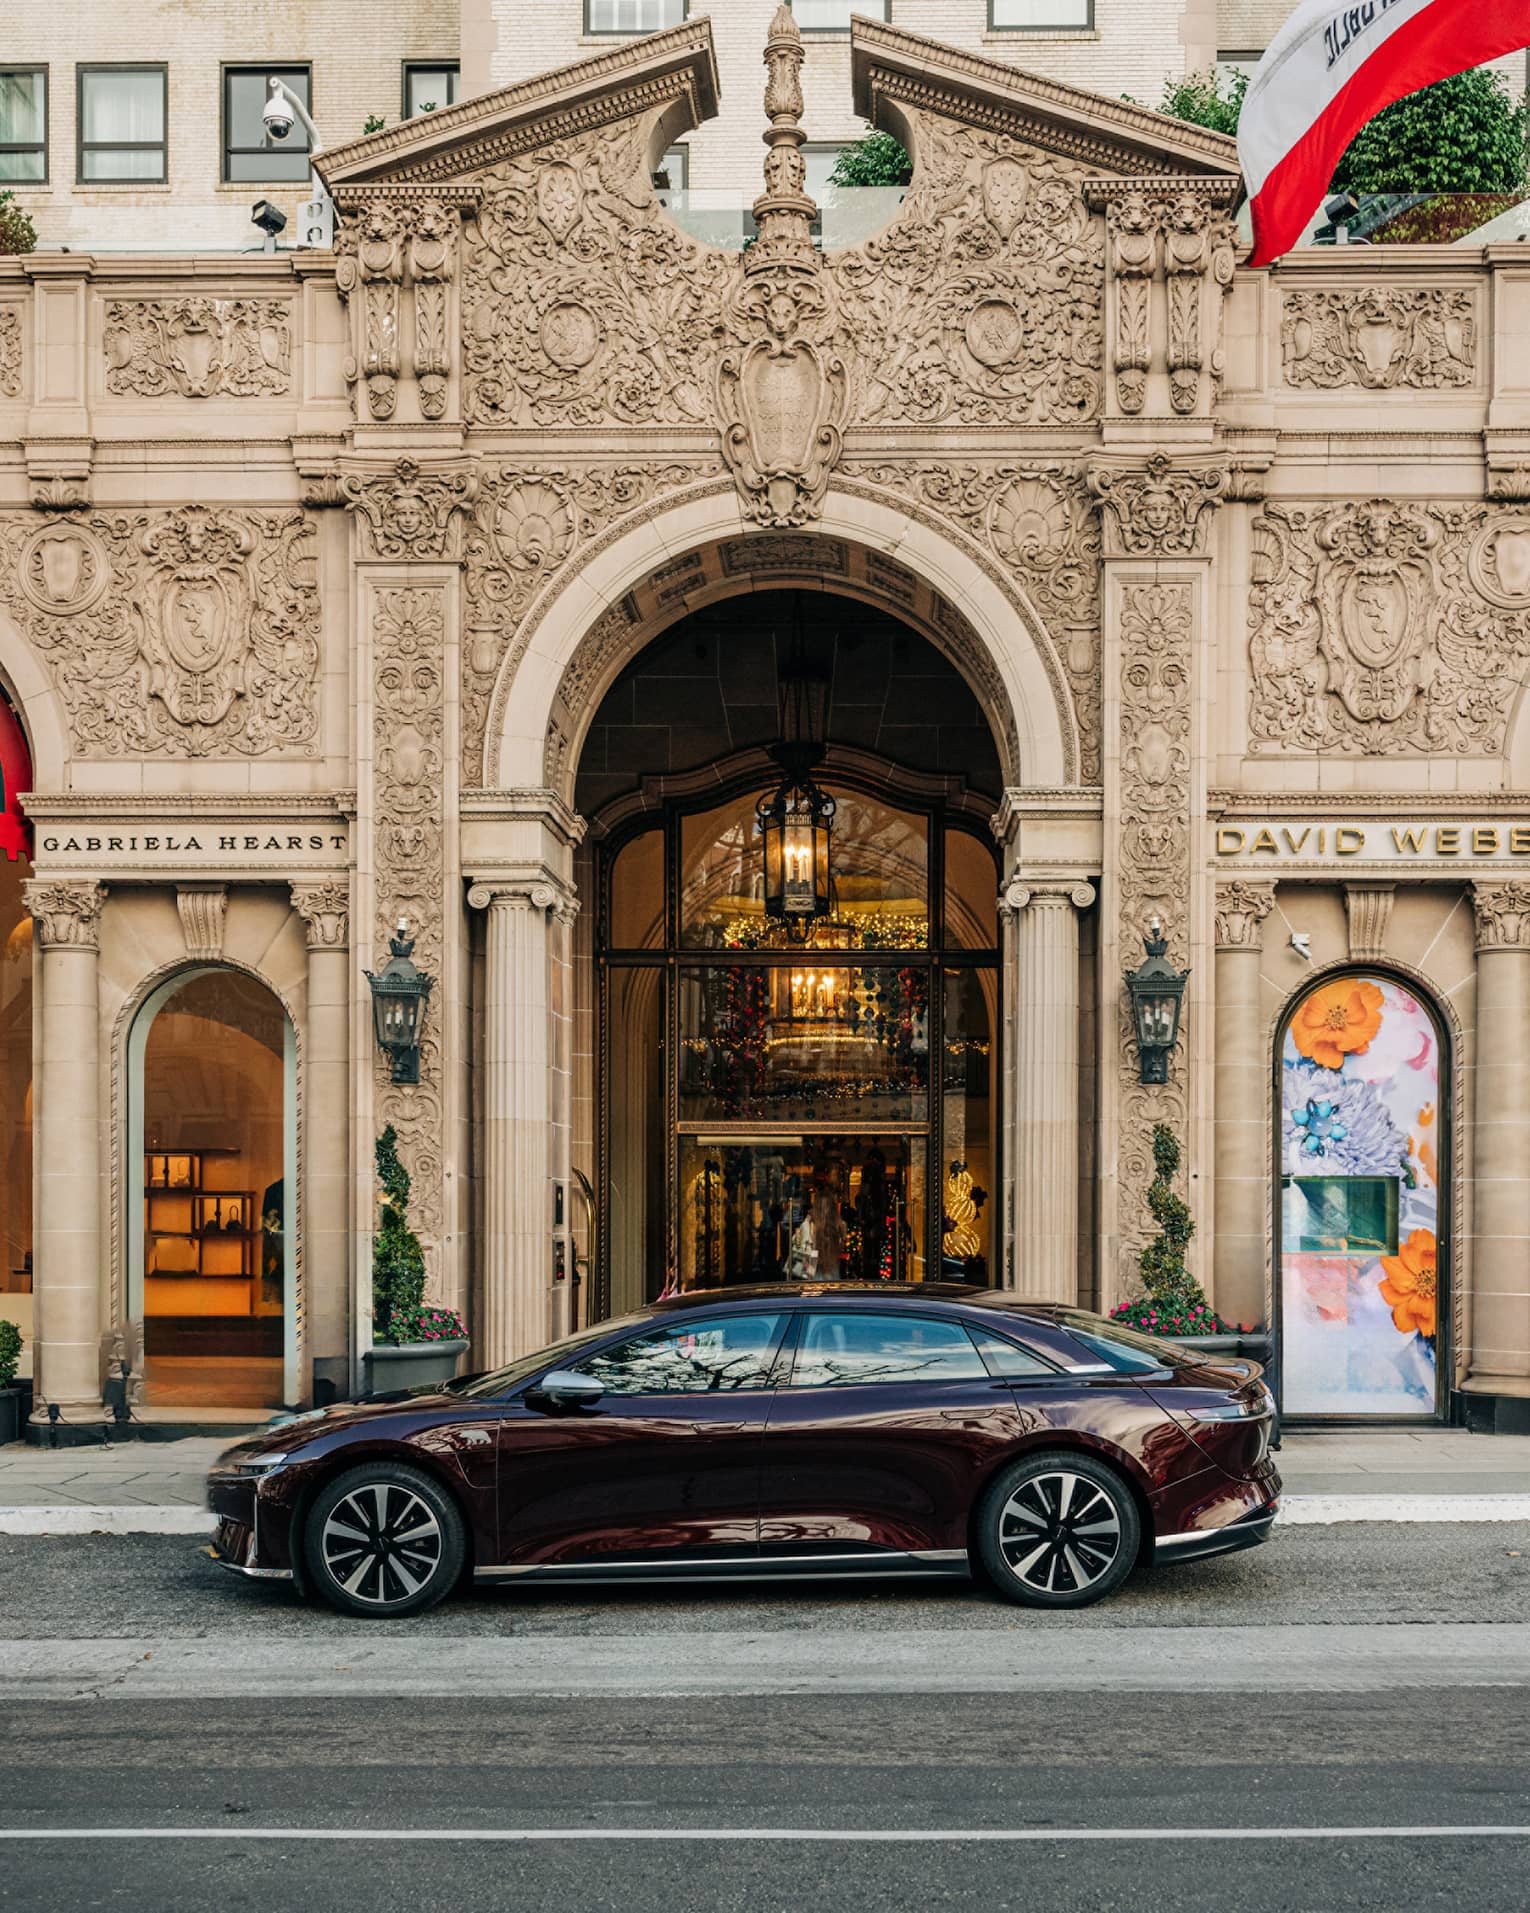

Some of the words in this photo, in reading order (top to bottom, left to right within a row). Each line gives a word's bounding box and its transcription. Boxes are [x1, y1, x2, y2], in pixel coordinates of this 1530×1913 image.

[43, 836, 203, 852] GABRIELA
[219, 835, 347, 850] HEARST
[1216, 827, 1365, 854] DAVID
